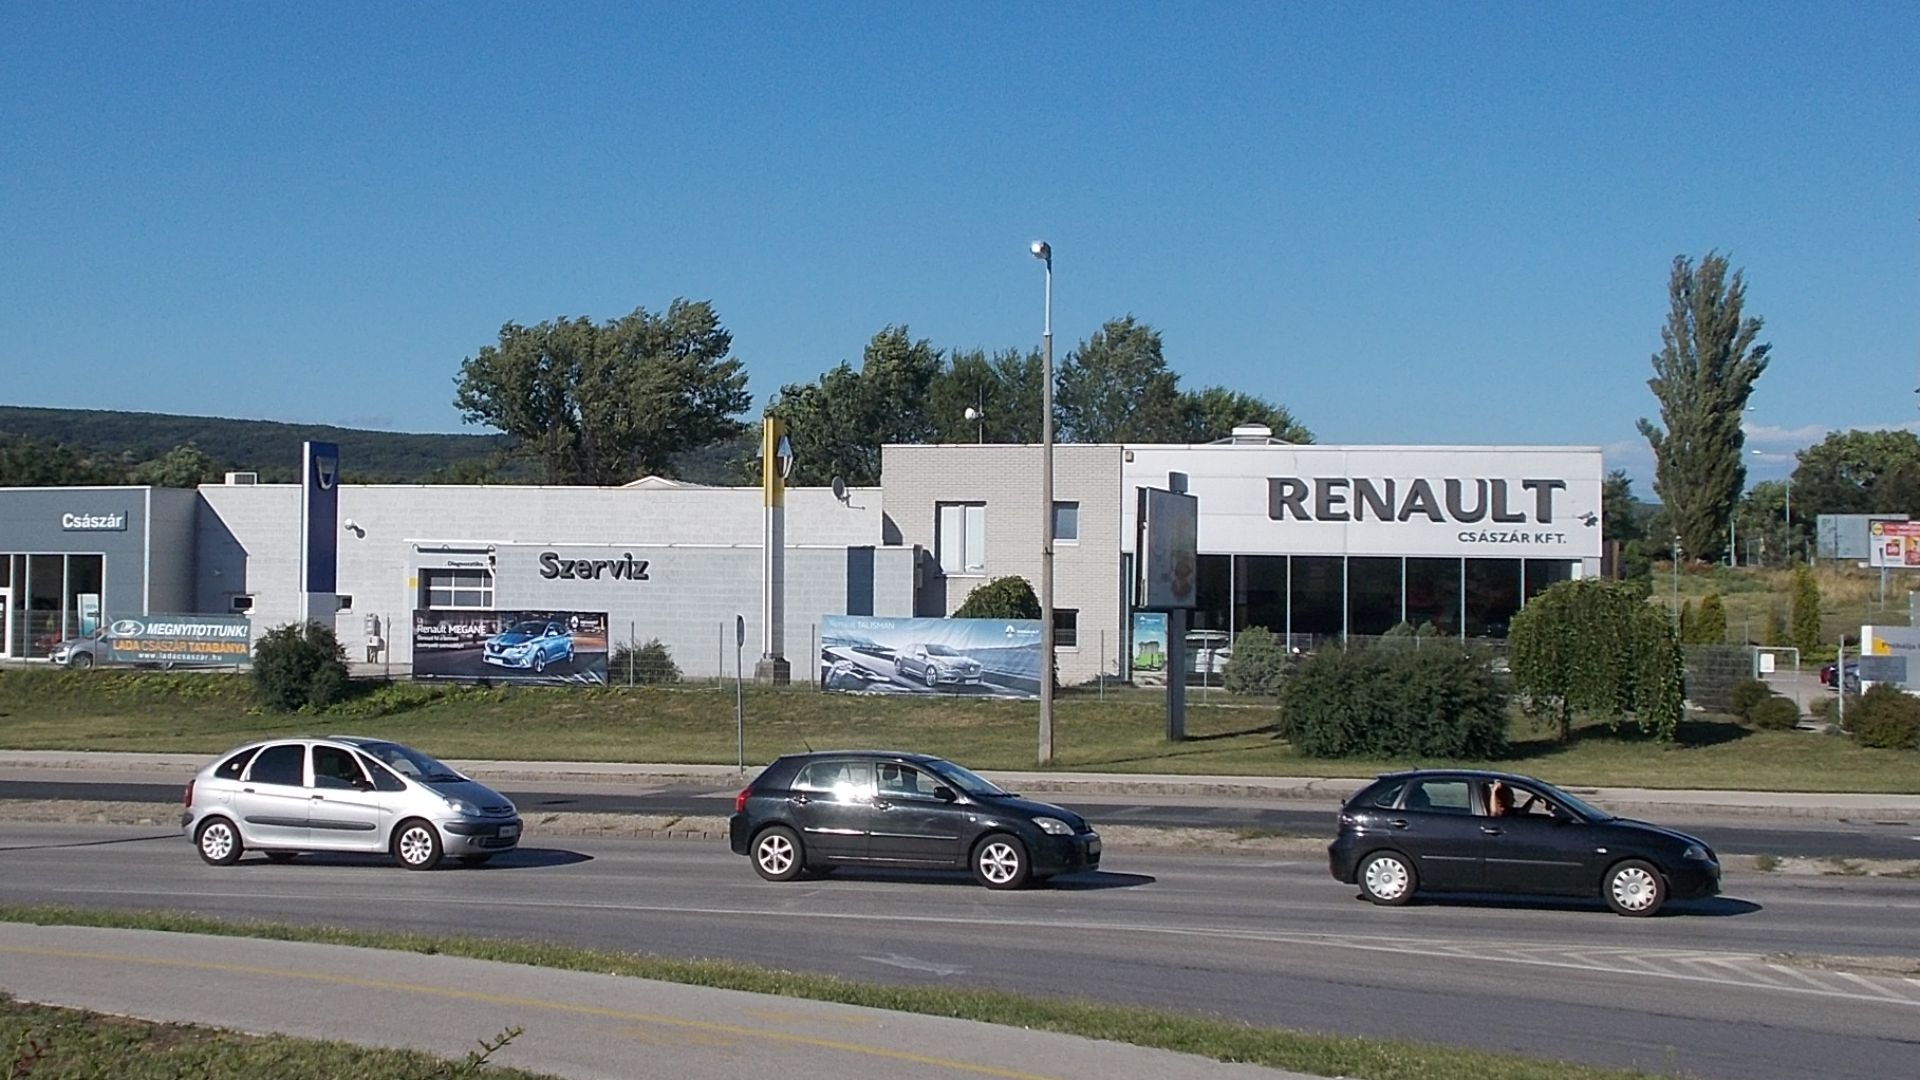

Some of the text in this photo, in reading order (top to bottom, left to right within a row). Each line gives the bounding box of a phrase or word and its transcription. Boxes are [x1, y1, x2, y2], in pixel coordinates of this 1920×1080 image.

[1266, 477, 1567, 524] RENAULT
[62, 512, 123, 528] Császár
[1457, 528, 1567, 544] CSÁSZÁR KFT.
[539, 552, 650, 580] Szerviz
[146, 622, 249, 637] MEGNYITOTTUNK!
[416, 624, 487, 634] Renault MEGANE
[112, 639, 140, 651] LADA
[188, 640, 248, 653] TATABÁNYA
[138, 652, 223, 661] www.ladacsaszar.hu
